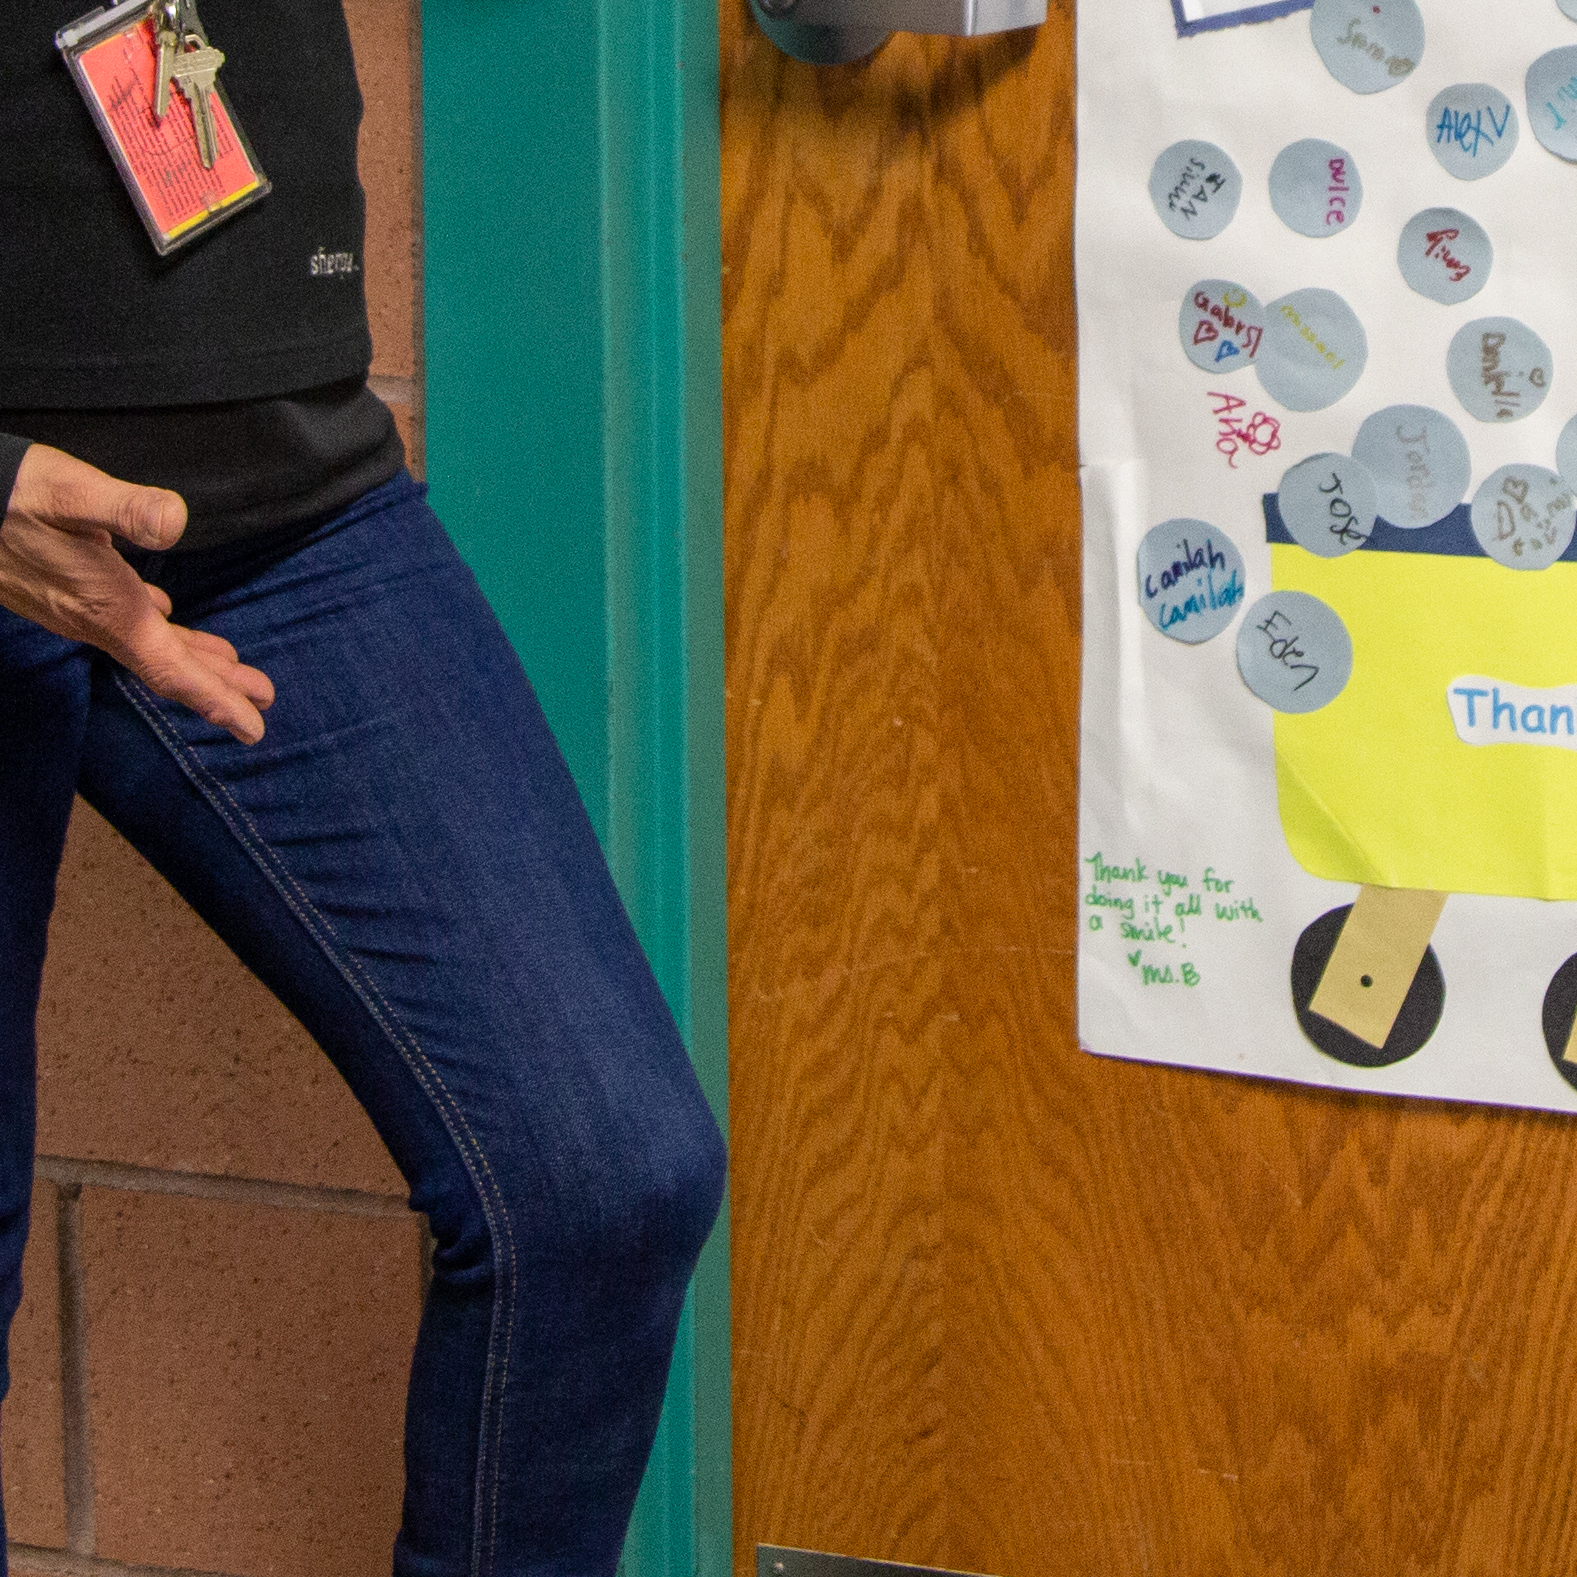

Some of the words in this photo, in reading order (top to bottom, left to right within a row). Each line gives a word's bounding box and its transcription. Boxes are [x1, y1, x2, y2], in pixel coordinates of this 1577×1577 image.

[1085, 851, 1149, 883] Thank
[1158, 870, 1188, 897] you
[1202, 866, 1235, 893] for
[1085, 884, 1135, 920] doing
[1144, 894, 1163, 914] it
[1174, 894, 1202, 917] all
[1214, 896, 1263, 923] with
[1088, 915, 1103, 931] a
[1181, 962, 1201, 987] B
